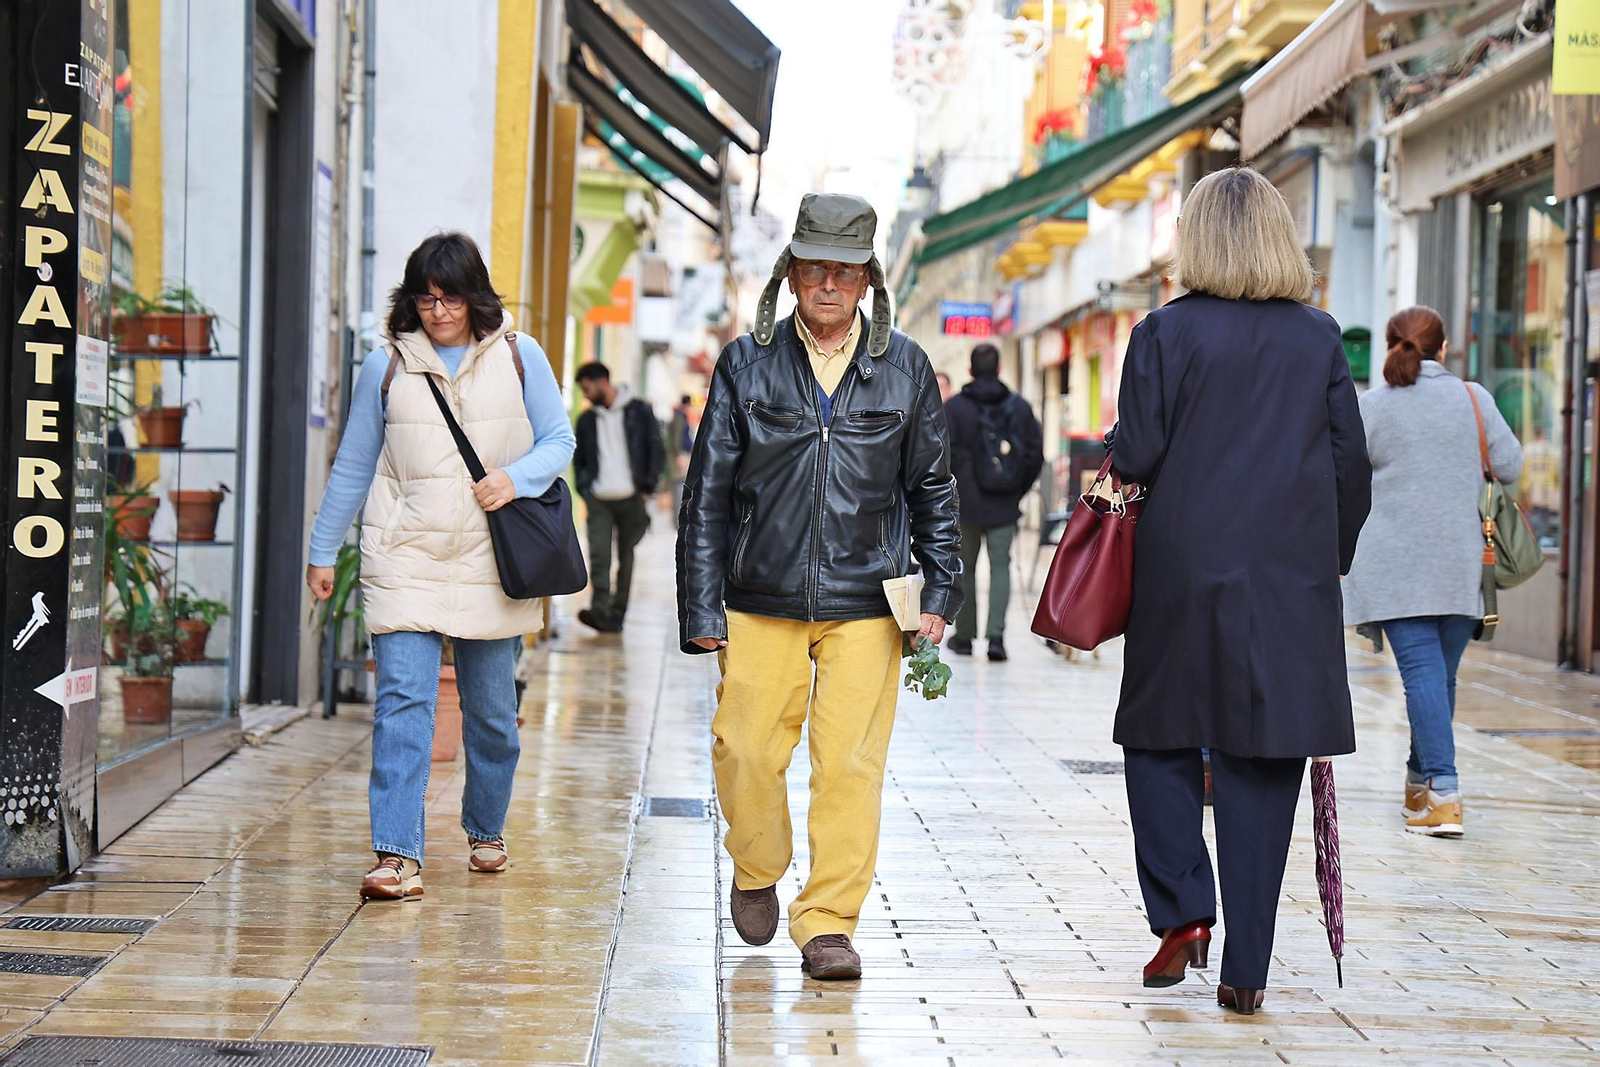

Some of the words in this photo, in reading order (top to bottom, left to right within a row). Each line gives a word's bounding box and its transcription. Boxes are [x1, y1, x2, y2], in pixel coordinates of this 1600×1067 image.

[80, 41, 112, 79] ZAPATERO
[13, 108, 75, 558] ZAPATERO
[66, 679, 73, 697] EN
